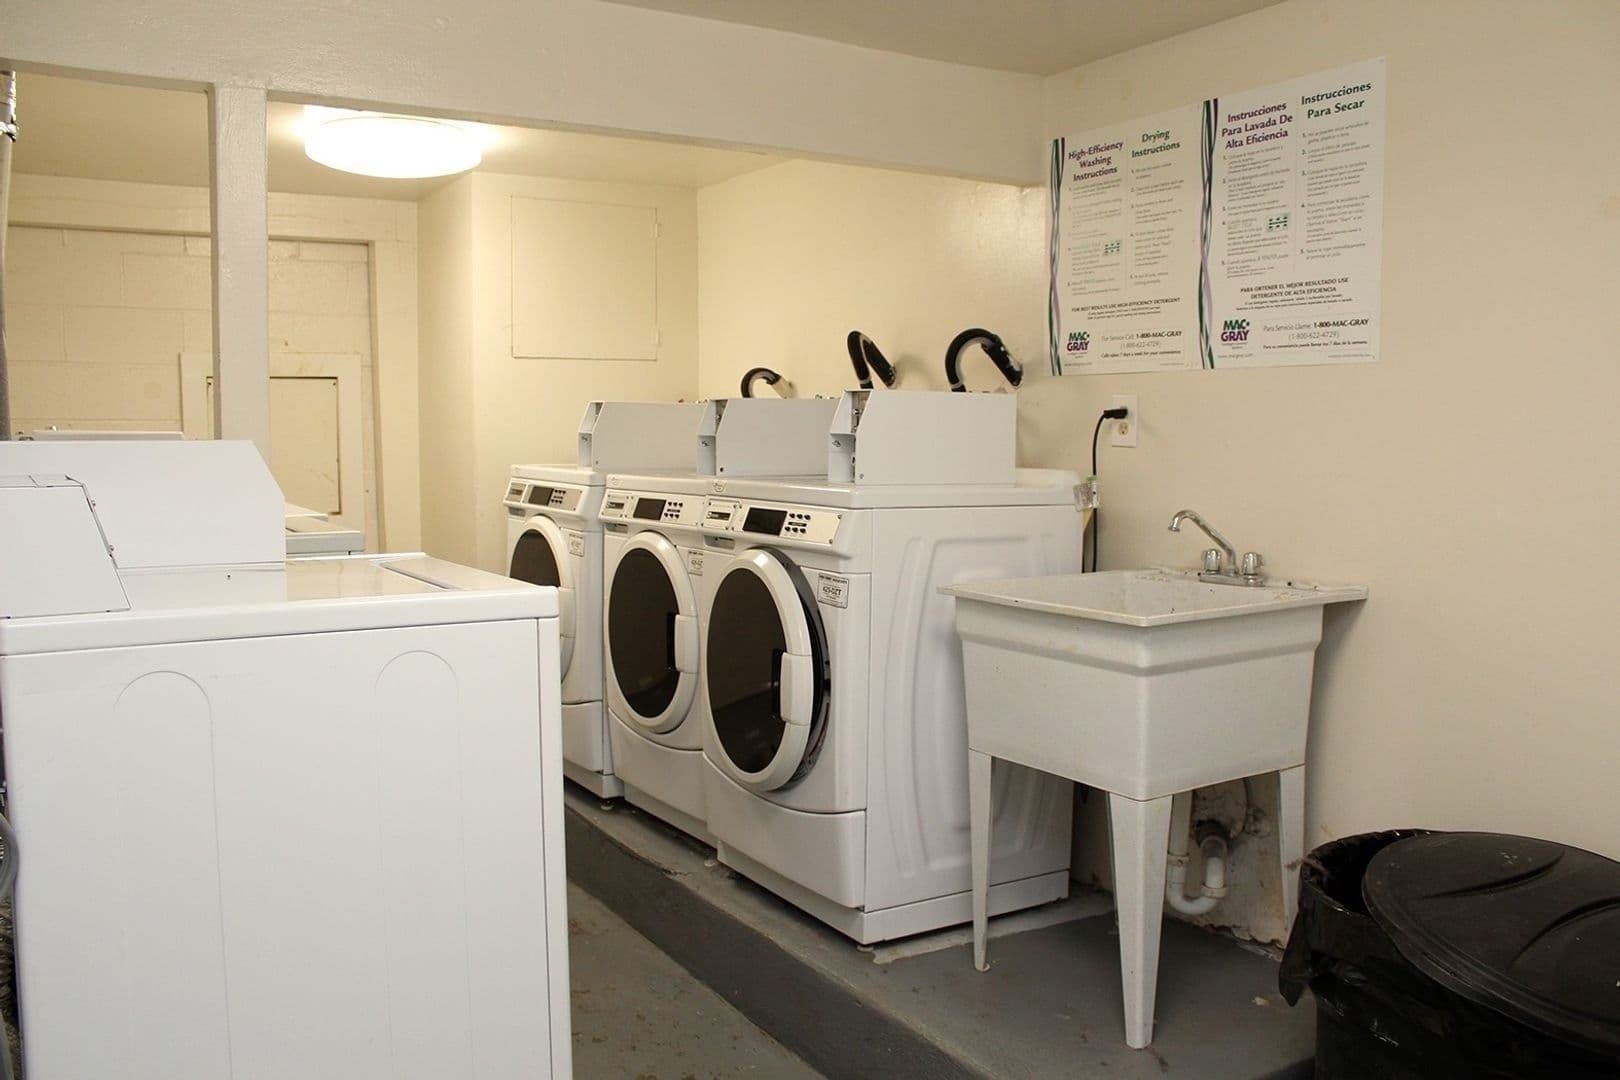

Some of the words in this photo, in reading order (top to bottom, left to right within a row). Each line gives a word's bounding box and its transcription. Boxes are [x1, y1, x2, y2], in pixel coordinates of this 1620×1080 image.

[1301, 82, 1372, 105] Instrucciones
[1227, 102, 1287, 123] Instrucciones
[1307, 107, 1331, 119] Para
[1334, 99, 1365, 114] Secar
[1221, 125, 1242, 137] Para
[1244, 118, 1277, 132] Lavada
[1279, 114, 1293, 124] De
[1141, 129, 1171, 143] Drying
[1225, 138, 1244, 150] Alta
[1246, 129, 1289, 144] Eficiencia
[1068, 141, 1123, 160] High-Efficiency
[1131, 141, 1181, 158] Instructions
[1079, 156, 1112, 169] Washing
[1073, 167, 1118, 182] Instructions
[1304, 279, 1337, 287] RESULTADO
[1250, 291, 1283, 300] DETERGENTE
[1306, 286, 1337, 295] EFICIENCIA
[1312, 318, 1368, 328] 1-800-MAC-GRAY
[1135, 330, 1182, 339] 1-800-MAC-GRAY
[1220, 330, 1250, 342] GRAY
[1066, 341, 1090, 352] GRAY
